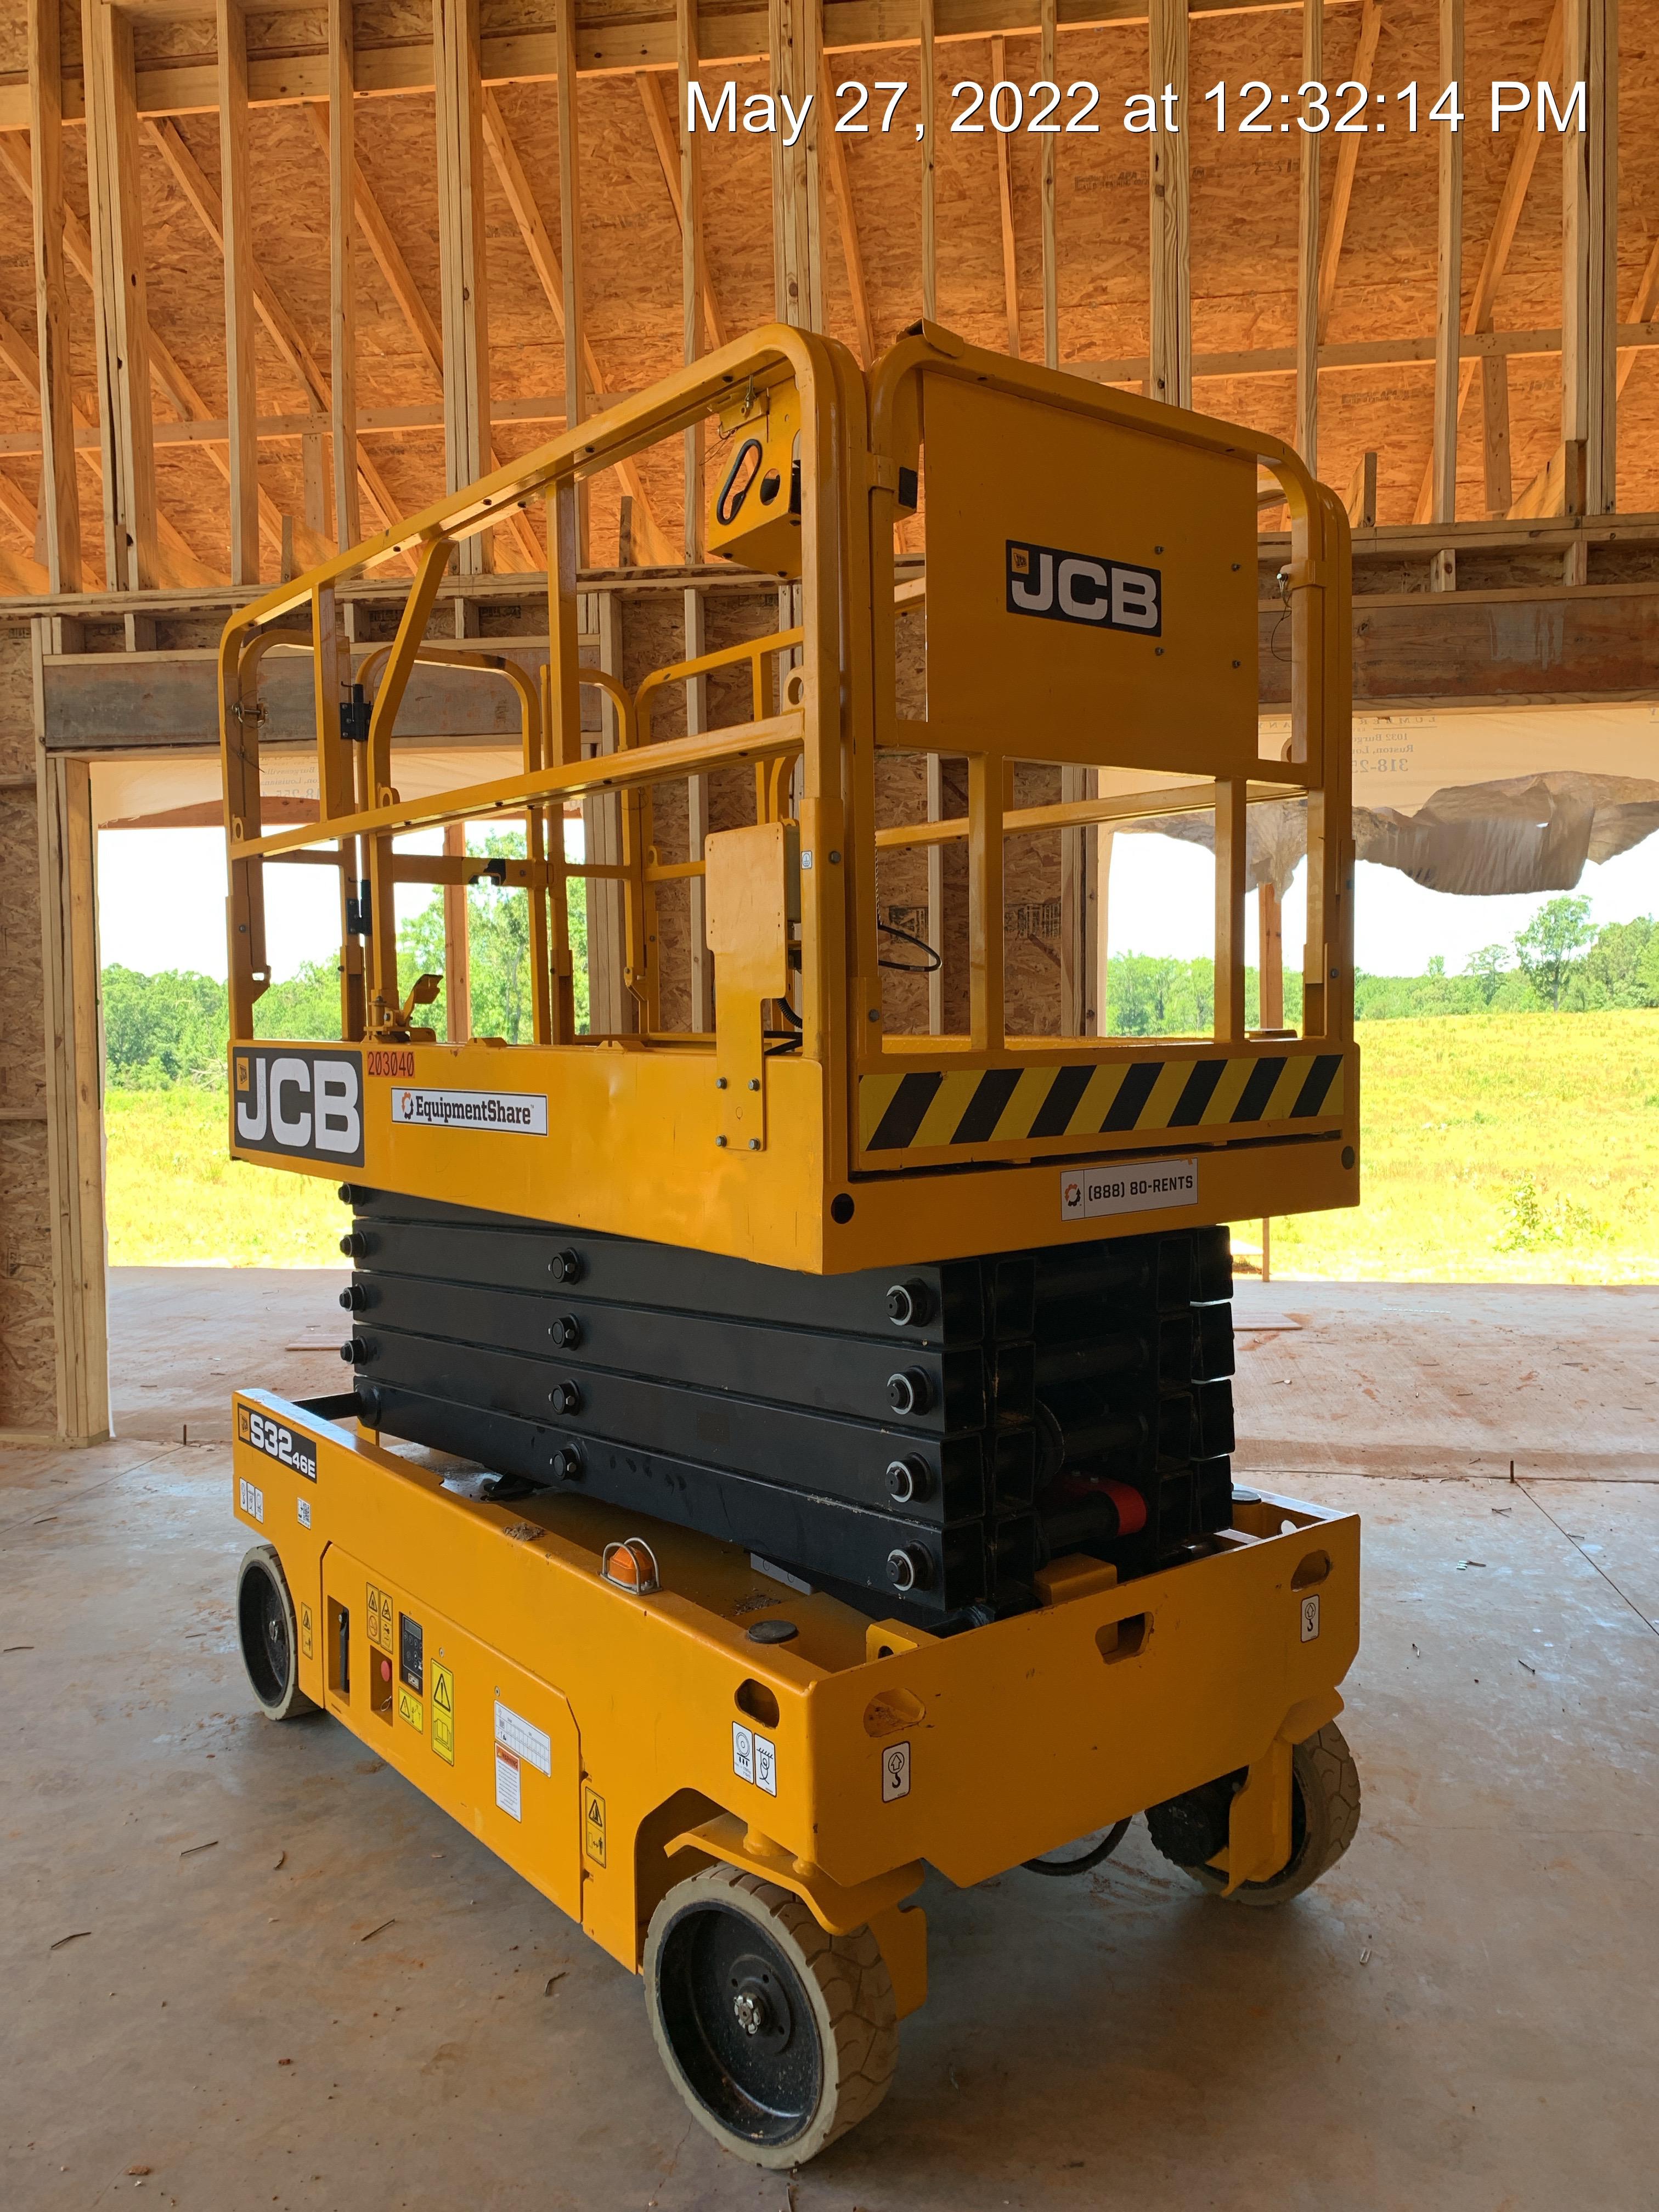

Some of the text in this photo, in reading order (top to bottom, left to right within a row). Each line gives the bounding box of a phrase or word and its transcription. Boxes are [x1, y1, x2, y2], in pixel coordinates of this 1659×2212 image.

[1011, 553, 1158, 629] JCB
[368, 1051, 414, 1077] 203040
[237, 1058, 360, 1153] JCB
[415, 1095, 532, 1125] EquipmentShare
[1088, 1175, 1193, 1201] (888) 80-RENTS
